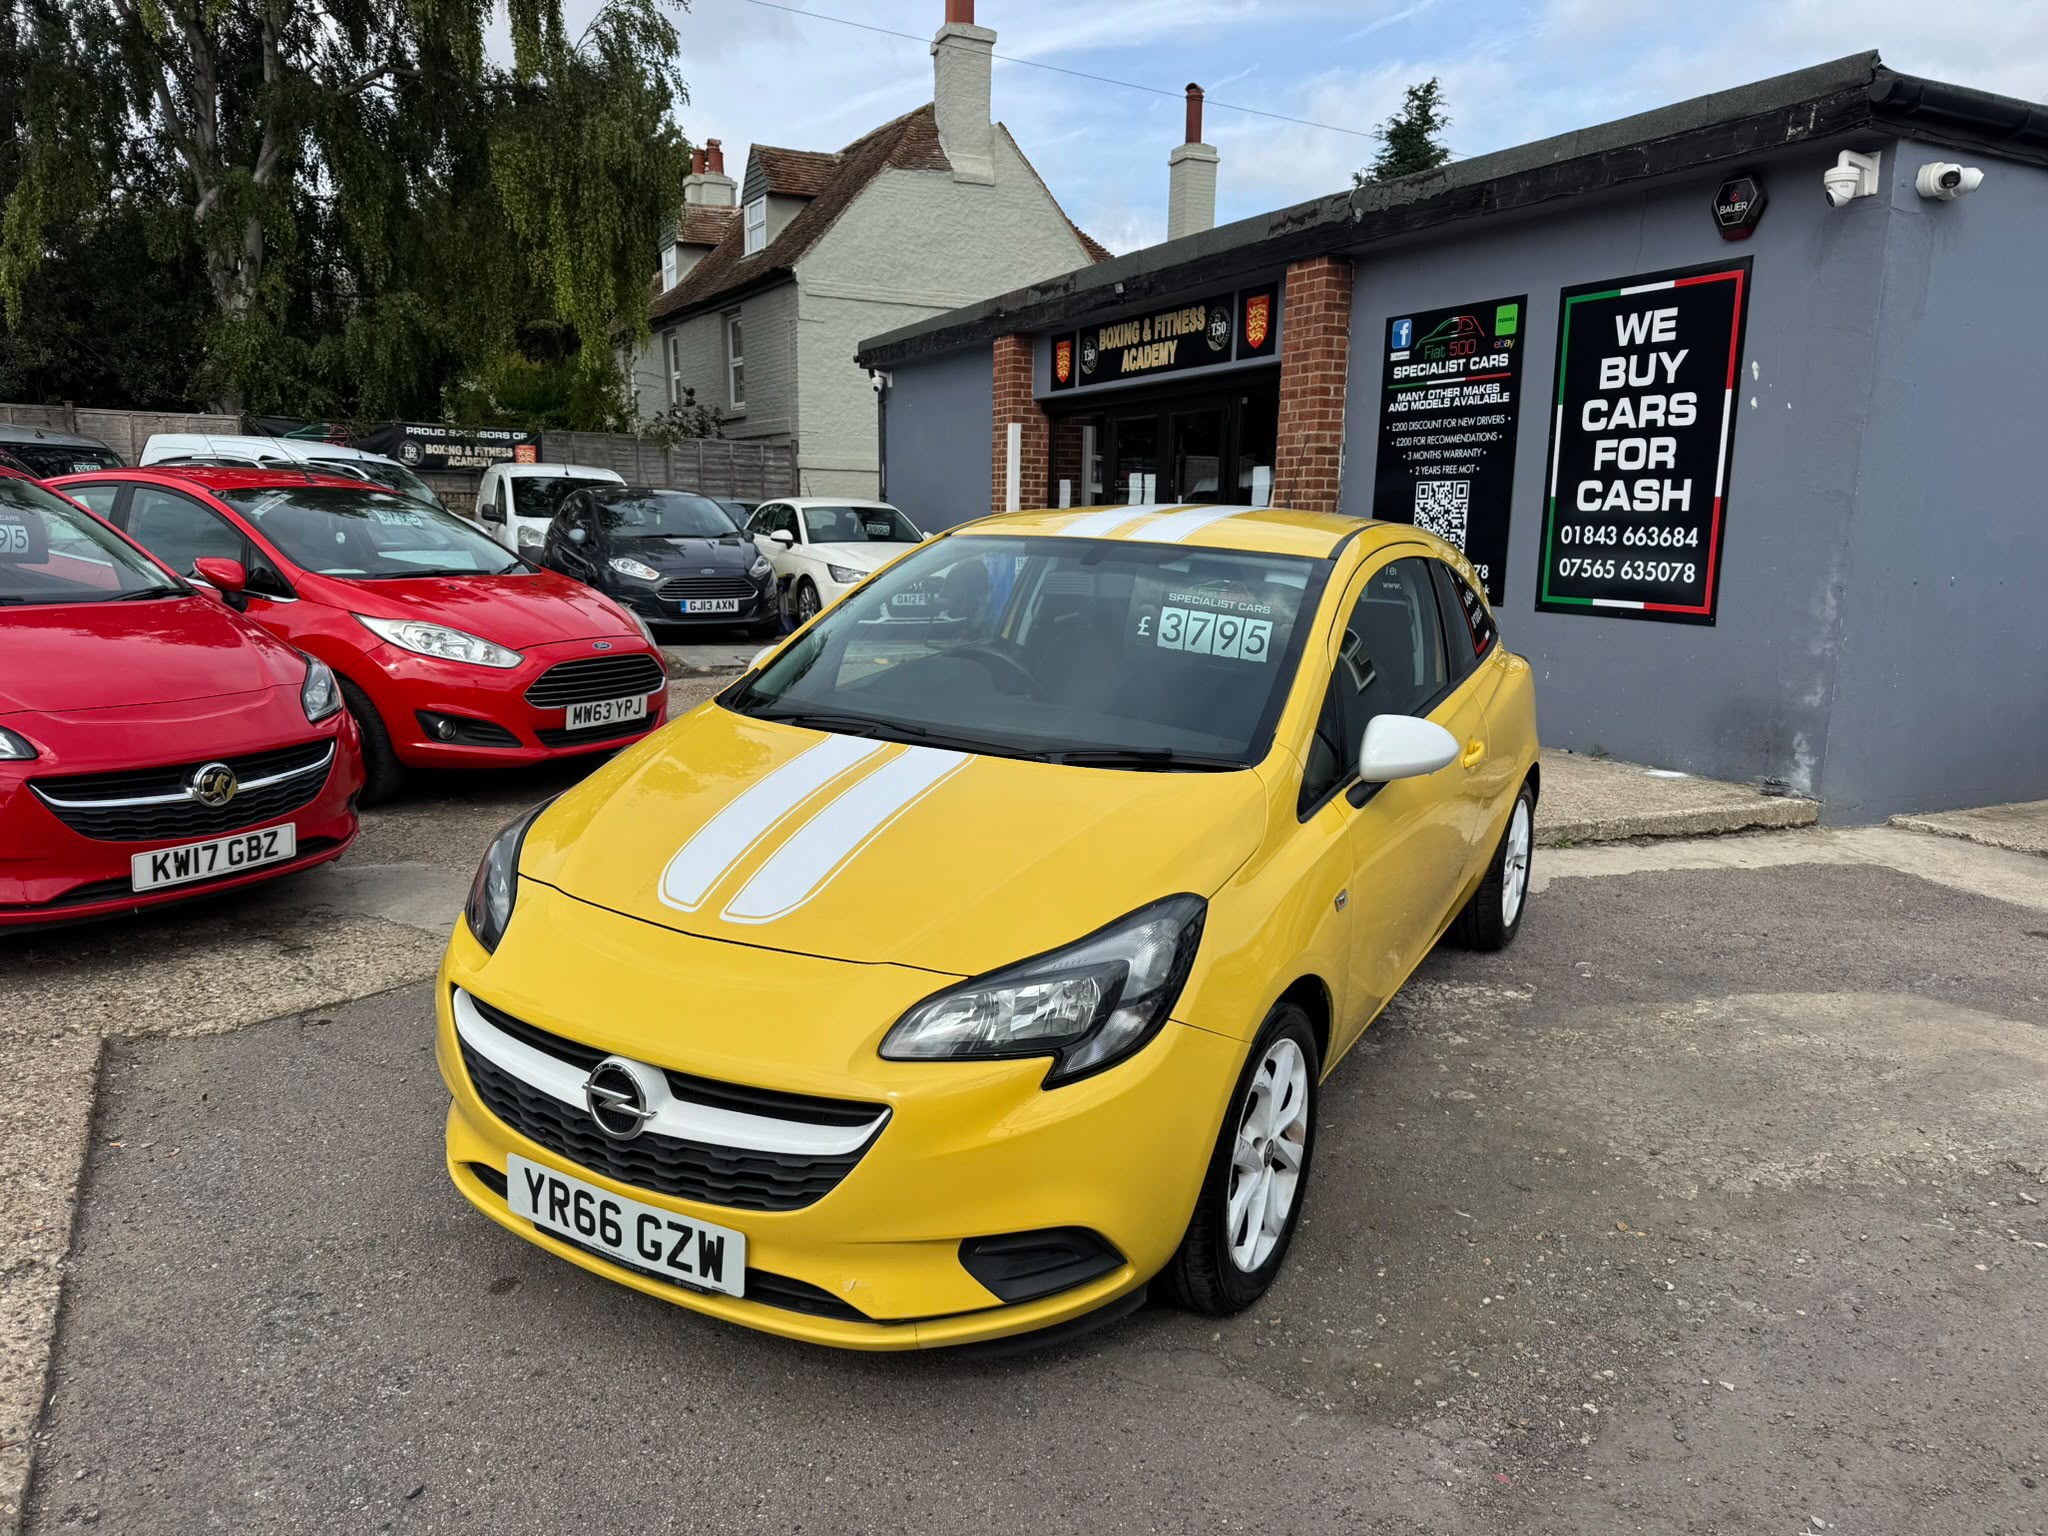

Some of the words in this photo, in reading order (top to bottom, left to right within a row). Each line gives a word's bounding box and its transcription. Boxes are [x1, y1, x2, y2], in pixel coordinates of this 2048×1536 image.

[1720, 201, 1748, 215] BAUER
[1099, 321, 1140, 351] BOXING
[1142, 318, 1151, 342] &
[1154, 305, 1206, 340] FITNESS
[1615, 307, 1679, 347] WE
[1424, 344, 1446, 360] Fiat
[1449, 339, 1477, 357] 500
[1493, 338, 1516, 349] ebay
[1121, 340, 1178, 373] ACADEMY
[1393, 358, 1466, 379] SPECIALIST
[1469, 353, 1509, 370] CARS
[1599, 349, 1690, 391] BUY
[1388, 402, 1408, 412] AND
[1410, 399, 1450, 411] MODELS
[1452, 392, 1510, 407] AVAILABLE
[1397, 390, 1426, 402] MANY
[1427, 387, 1460, 400] OTHER
[1462, 383, 1500, 396] MAKES
[1391, 422, 1408, 432] £200
[1408, 419, 1442, 431] DISCOUNT
[1442, 418, 1457, 428] FOR
[1457, 416, 1476, 427] NEW
[1476, 414, 1505, 426] DRIVERS
[1581, 392, 1698, 432] CARS
[405, 426, 446, 436] PROUD
[448, 428, 511, 440] SPSORS
[512, 431, 528, 440] OF
[1396, 437, 1412, 447] £200
[1412, 436, 1426, 446] FOR
[1426, 431, 1498, 445] RECOMMENDATIONS
[447, 456, 494, 467] ACADEMY
[465, 446, 472, 456] &
[1407, 451, 1412, 460] 3
[1412, 450, 1442, 460] MONTHS
[1442, 447, 1482, 459] WARRANTY
[1593, 436, 1677, 472] FOR
[1415, 466, 1420, 476] 2
[1420, 465, 1441, 475] YEARS
[1442, 464, 1457, 474] FREE
[1458, 464, 1476, 474] MOT
[1576, 478, 1692, 512] CASH
[1560, 525, 1617, 545] 01843
[1622, 526, 1699, 548] 663684
[1558, 558, 1616, 579] 07565
[1620, 560, 1696, 583] 635078
[690, 600, 713, 611] GJ13
[715, 600, 735, 610] AXN
[1168, 592, 1237, 610] SPECIALIST
[1238, 602, 1272, 615] CARS
[1137, 616, 1152, 636] £
[1161, 613, 1268, 655] 3795
[572, 702, 612, 725] MW63
[615, 697, 642, 718] YPJ
[152, 843, 219, 882] KW17
[228, 831, 279, 866] GBZ
[524, 1167, 623, 1248] YR66
[637, 1213, 725, 1283] GZW
